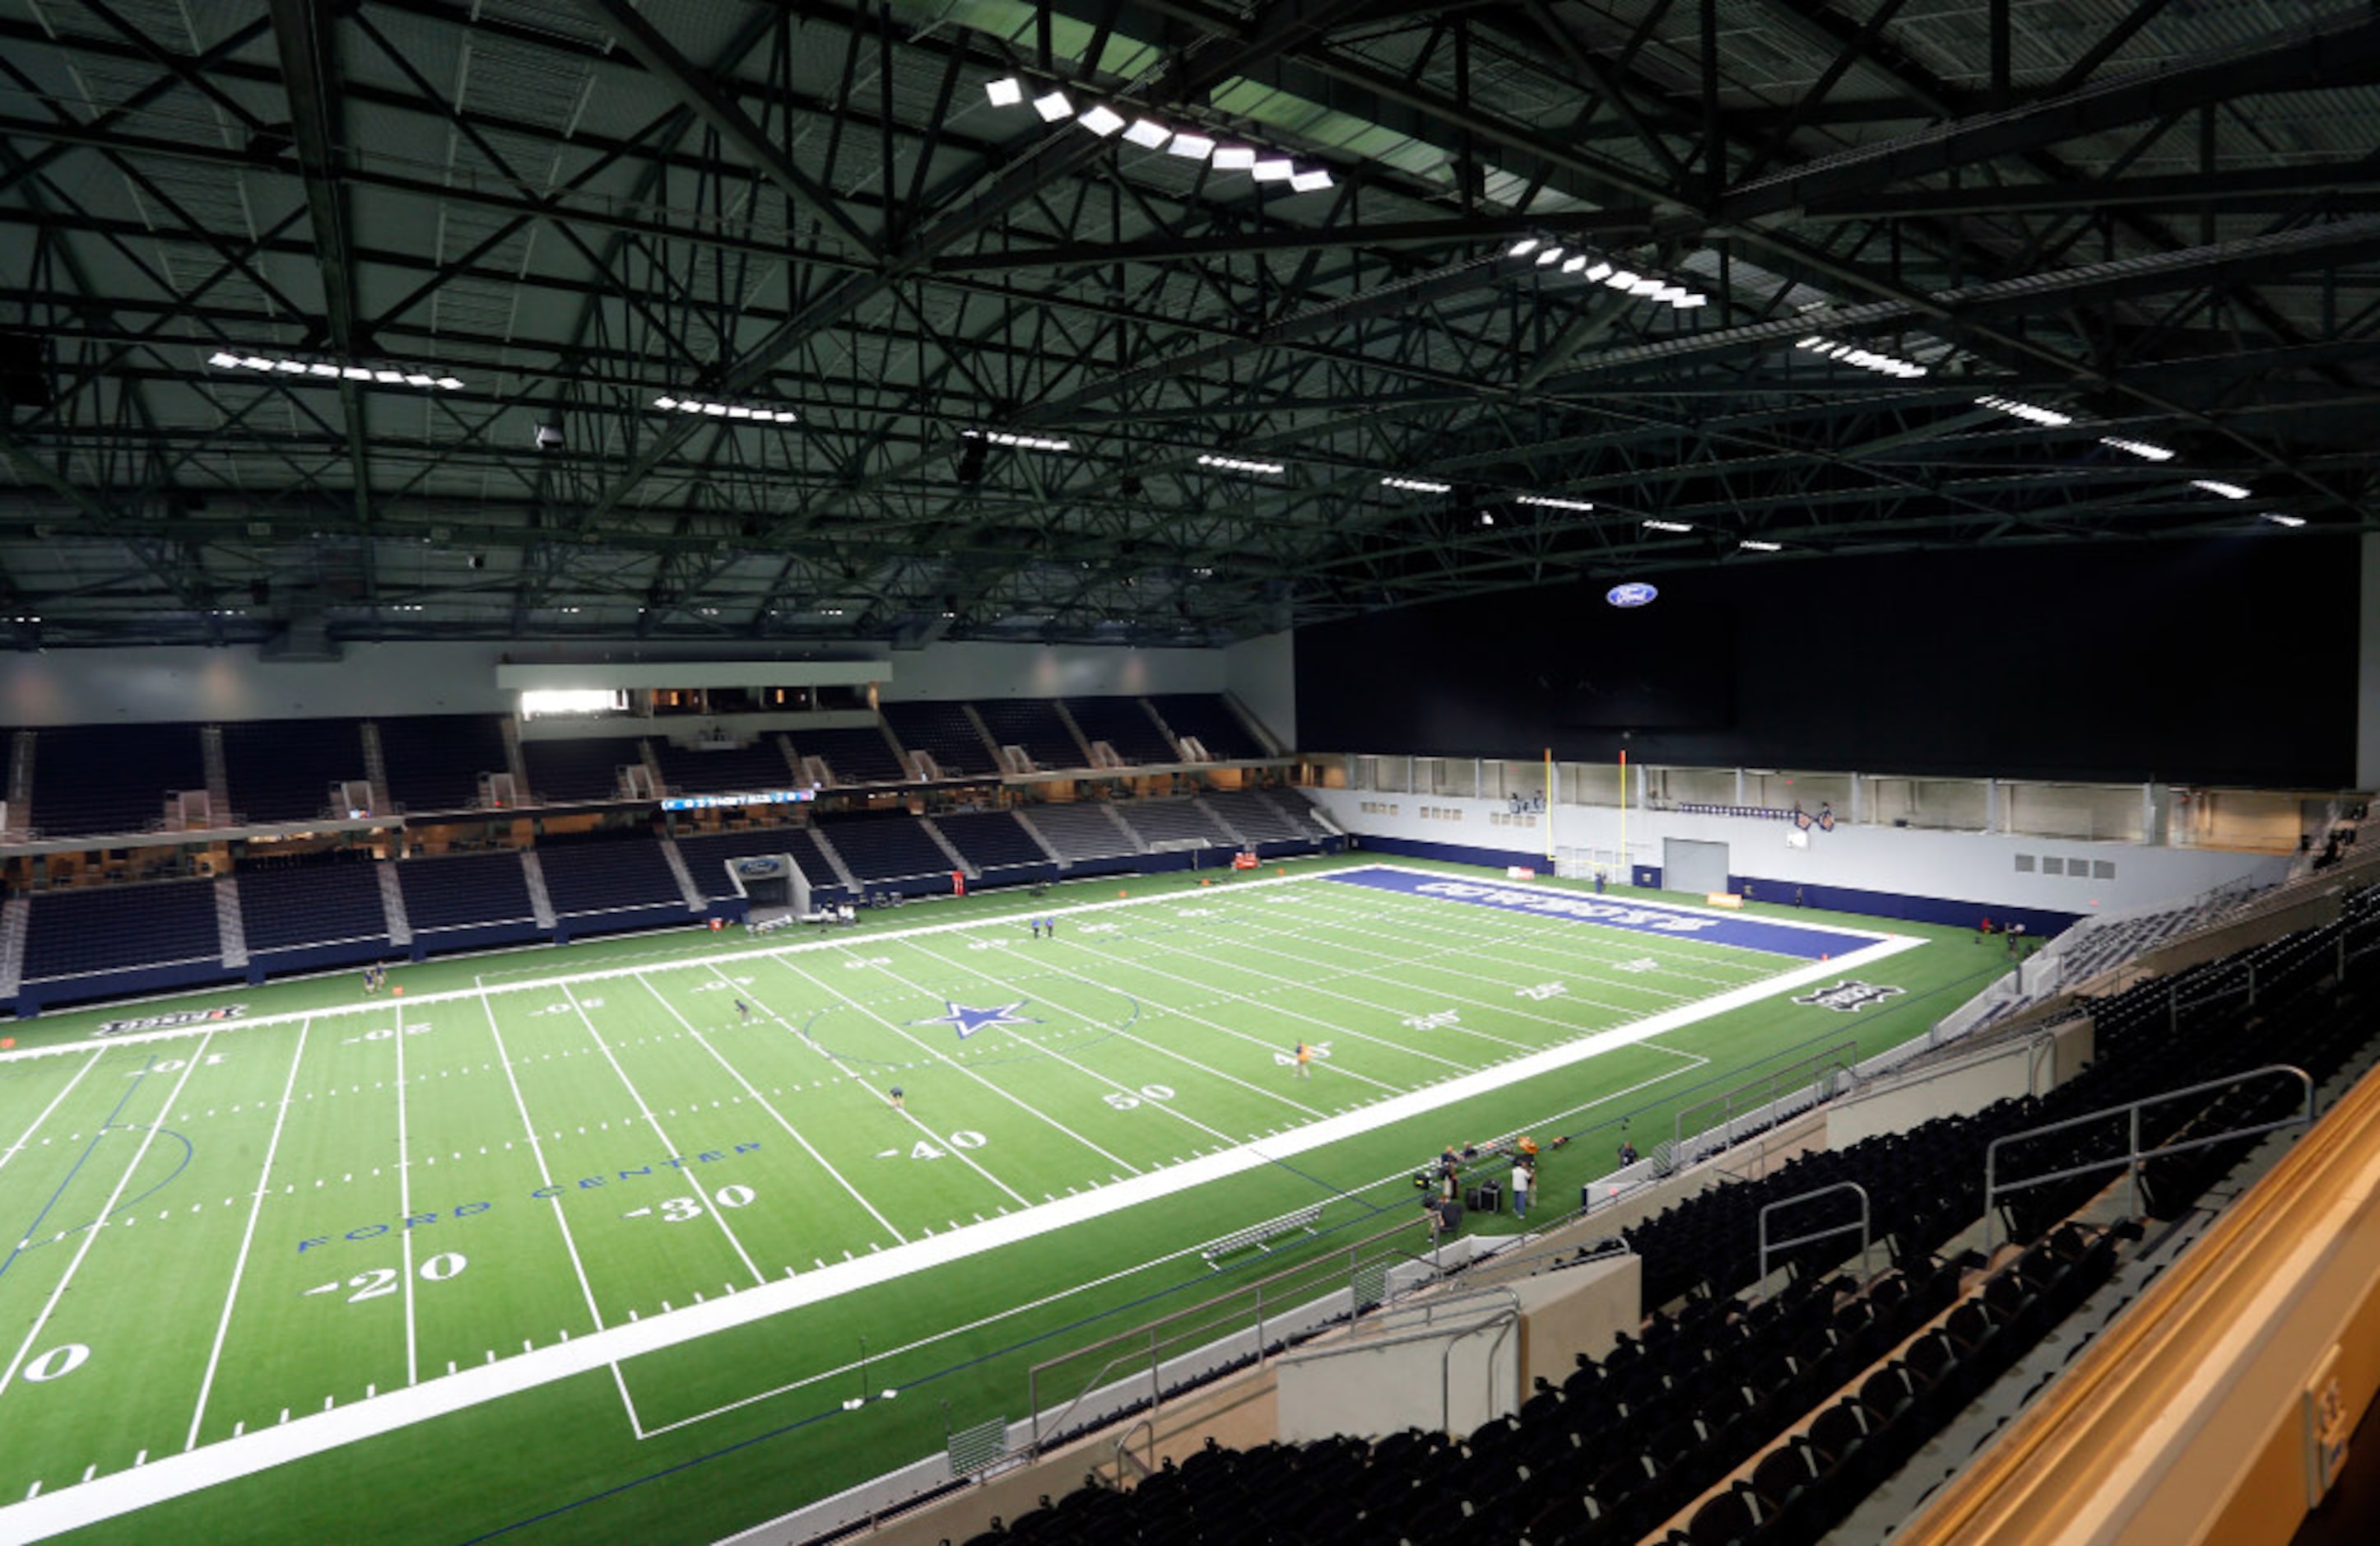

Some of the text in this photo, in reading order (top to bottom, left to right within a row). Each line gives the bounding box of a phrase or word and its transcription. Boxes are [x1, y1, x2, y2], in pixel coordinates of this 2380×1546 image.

[1103, 1083, 1176, 1111] 50
[909, 1129, 988, 1162] 40
[297, 1142, 761, 1253] FORD CENTER
[658, 1184, 756, 1222] 30
[346, 1252, 467, 1303] 20
